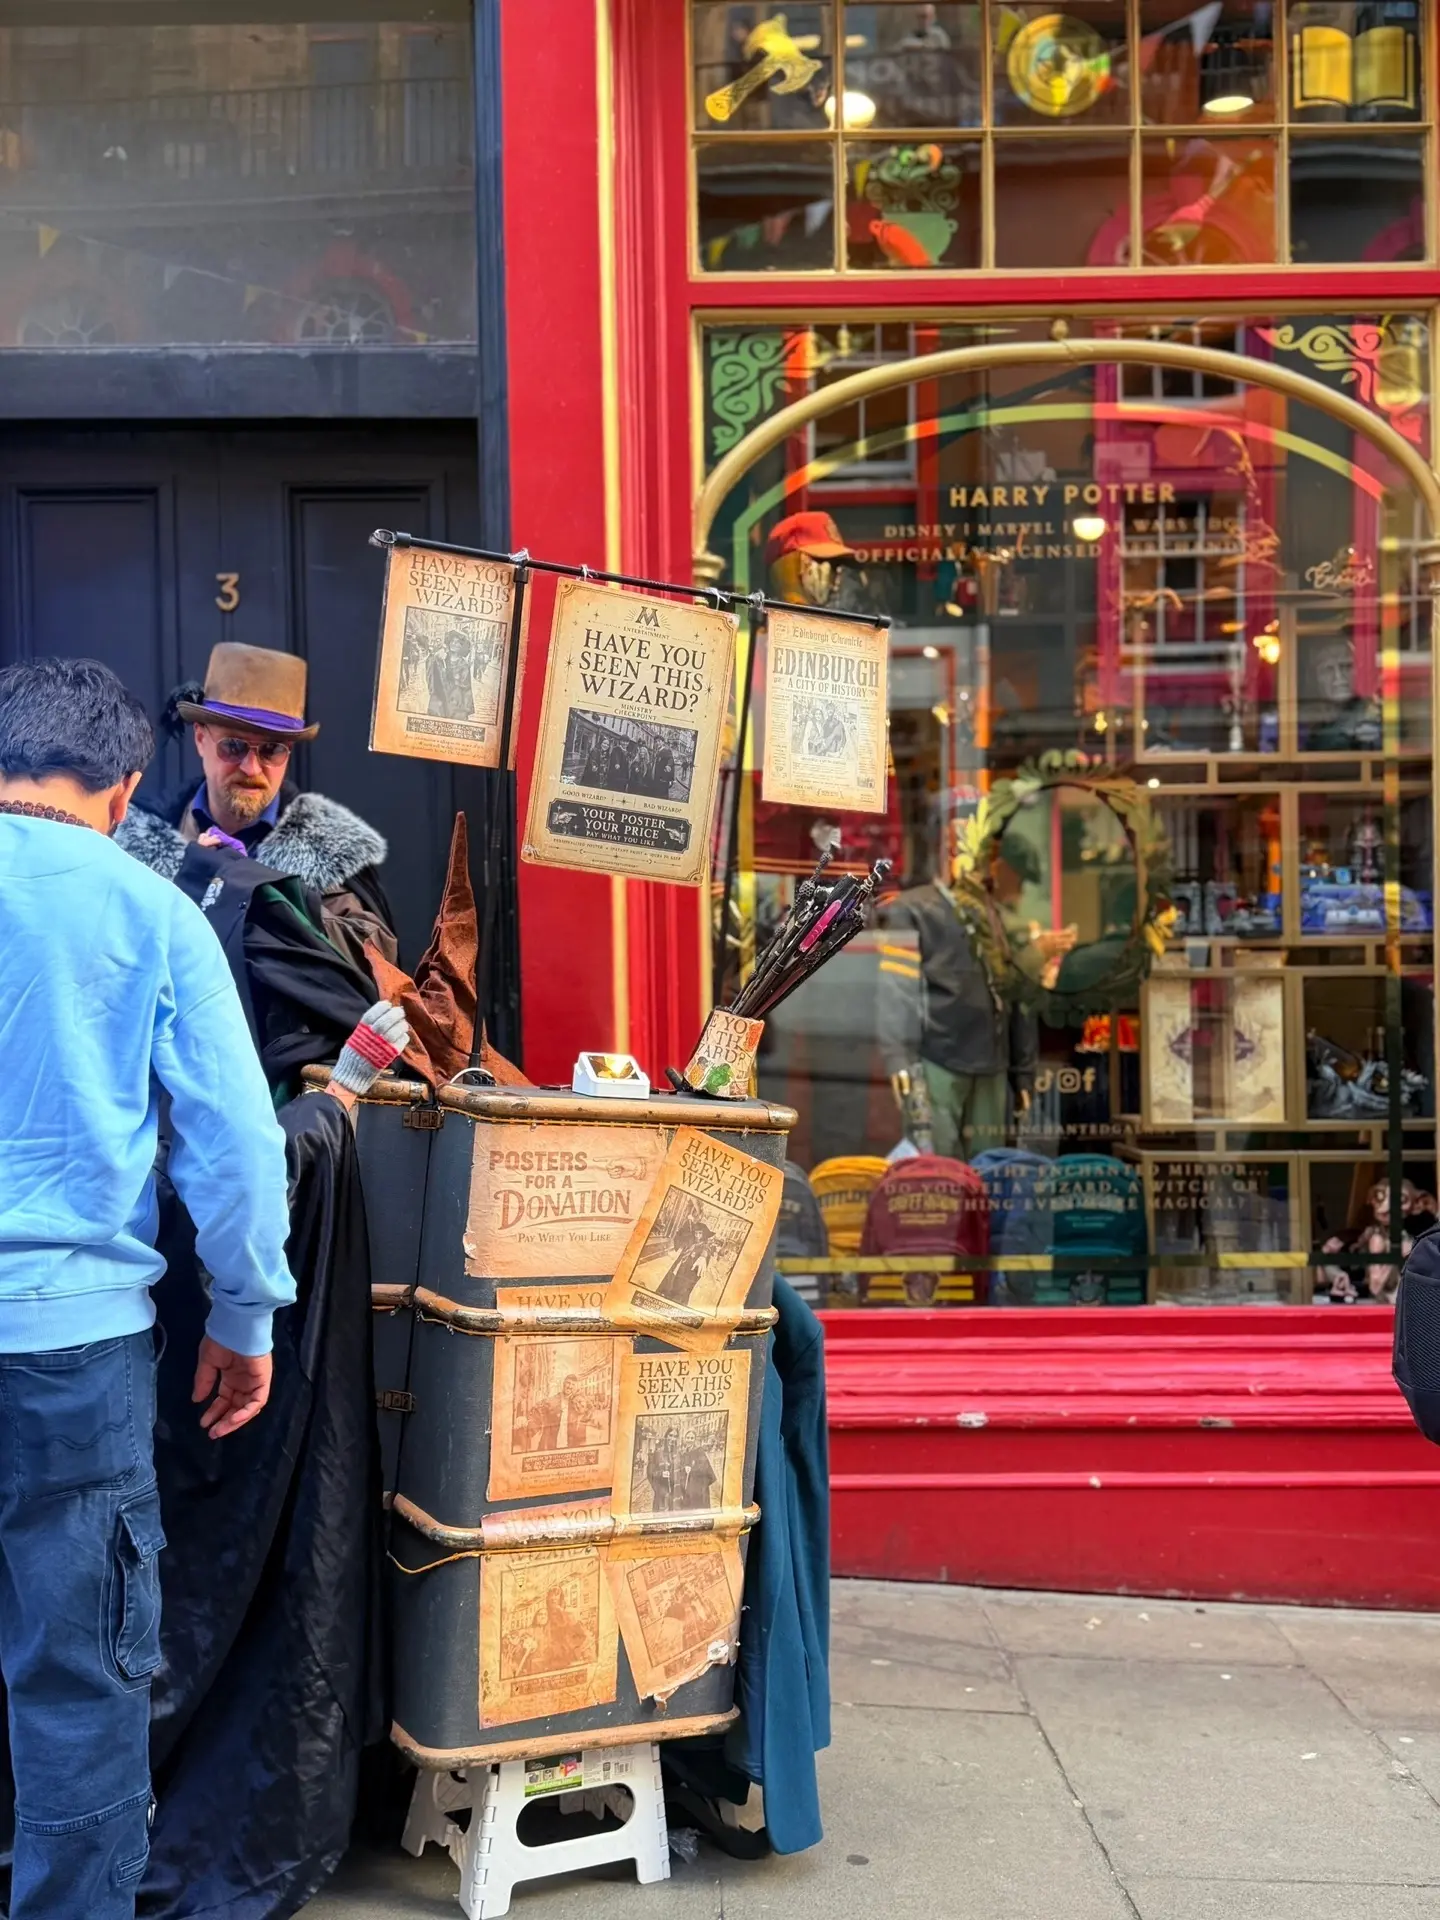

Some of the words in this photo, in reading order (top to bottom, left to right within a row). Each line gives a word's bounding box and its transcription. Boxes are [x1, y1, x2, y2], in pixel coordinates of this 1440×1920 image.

[950, 485, 1049, 508] HARRY
[1064, 482, 1176, 505] POTTER
[884, 523, 955, 539] DISNEY
[977, 520, 1054, 537] MARVEL
[854, 546, 986, 564] OFFICIALLY
[411, 554, 466, 577] HAVE
[474, 565, 513, 588] YOU
[215, 572, 239, 612] 3
[408, 571, 462, 594] SEEN
[468, 581, 511, 603] THIS
[415, 588, 502, 616] WIZARD?
[623, 626, 670, 640] ENTERTAINMENT
[793, 625, 829, 643] Edinburgh
[831, 632, 863, 648] Chronicle
[584, 628, 650, 660] HAVE
[660, 644, 707, 670] YOU
[579, 652, 641, 678] SEEN
[650, 664, 704, 692] THIS
[772, 646, 880, 688] EDINBURGH
[580, 673, 699, 713] WIZARD?
[787, 677, 793, 688] A
[795, 679, 816, 692] CITY
[818, 682, 830, 693] OF
[831, 683, 867, 698] HISTORY
[614, 708, 657, 721] CHECKPOINT
[621, 703, 653, 714] MINISTRY
[562, 789, 580, 798] GOOD
[581, 792, 607, 802] WIZARD?
[644, 802, 656, 810] BAD
[581, 807, 616, 822] YOUR
[620, 813, 666, 830] POSTER
[584, 818, 619, 834] YOUR
[624, 825, 659, 840] PRICE
[586, 831, 599, 839] PAY
[601, 833, 621, 841] WHAT
[624, 836, 638, 844] YOU
[640, 839, 655, 847] LIKE
[488, 1150, 588, 1171] POSTERS
[685, 1137, 735, 1172] HAVE
[737, 1160, 773, 1189] YOU
[525, 1175, 556, 1189] FOR
[559, 1175, 573, 1189] A
[678, 1155, 725, 1183] SEEN
[729, 1176, 767, 1204] THIS
[681, 1171, 755, 1213] WIZARD?
[493, 1189, 632, 1231] DONATION
[516, 1293, 571, 1309] HAVE
[577, 1291, 608, 1309] YO
[638, 1360, 690, 1378] HAVE
[696, 1358, 734, 1375] YOU
[637, 1377, 688, 1395] SEEN
[691, 1375, 732, 1392] THIS
[643, 1391, 724, 1410] WIZARD?
[562, 1506, 602, 1529] YOU
